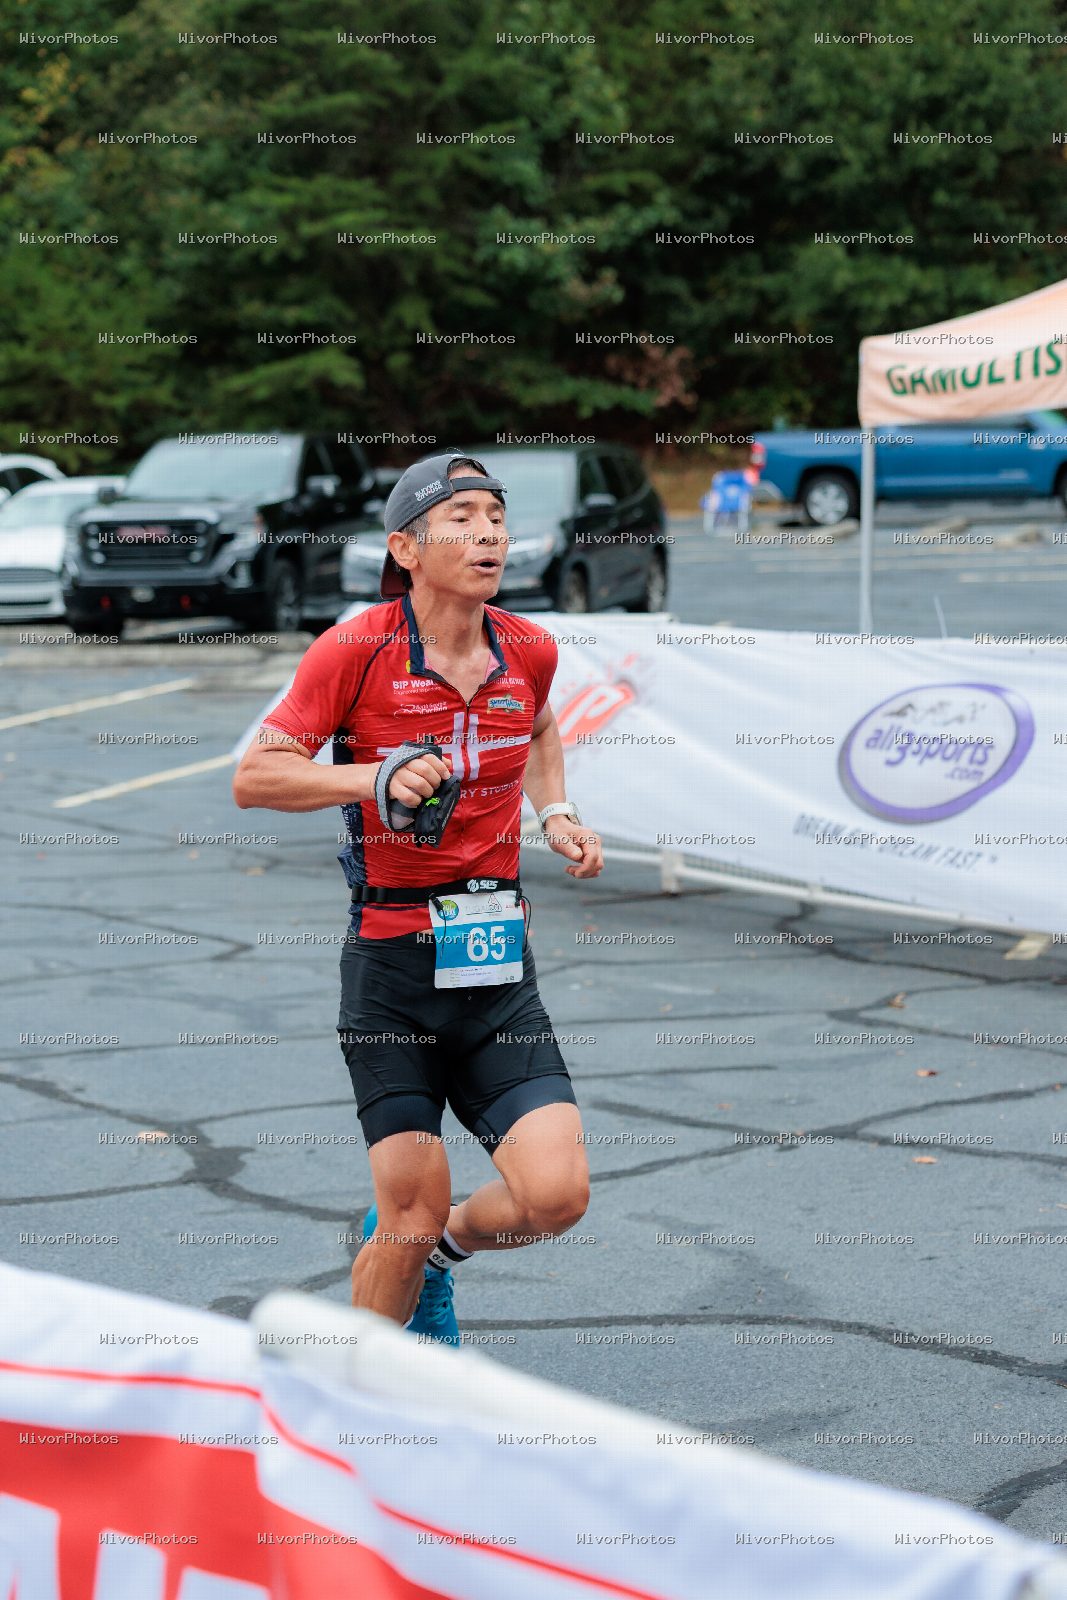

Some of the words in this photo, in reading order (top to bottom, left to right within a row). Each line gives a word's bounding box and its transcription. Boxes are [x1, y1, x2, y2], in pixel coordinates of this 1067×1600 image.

[393, 680, 409, 690] BIP
[467, 926, 506, 962] 65
[432, 1253, 446, 1265] 65
